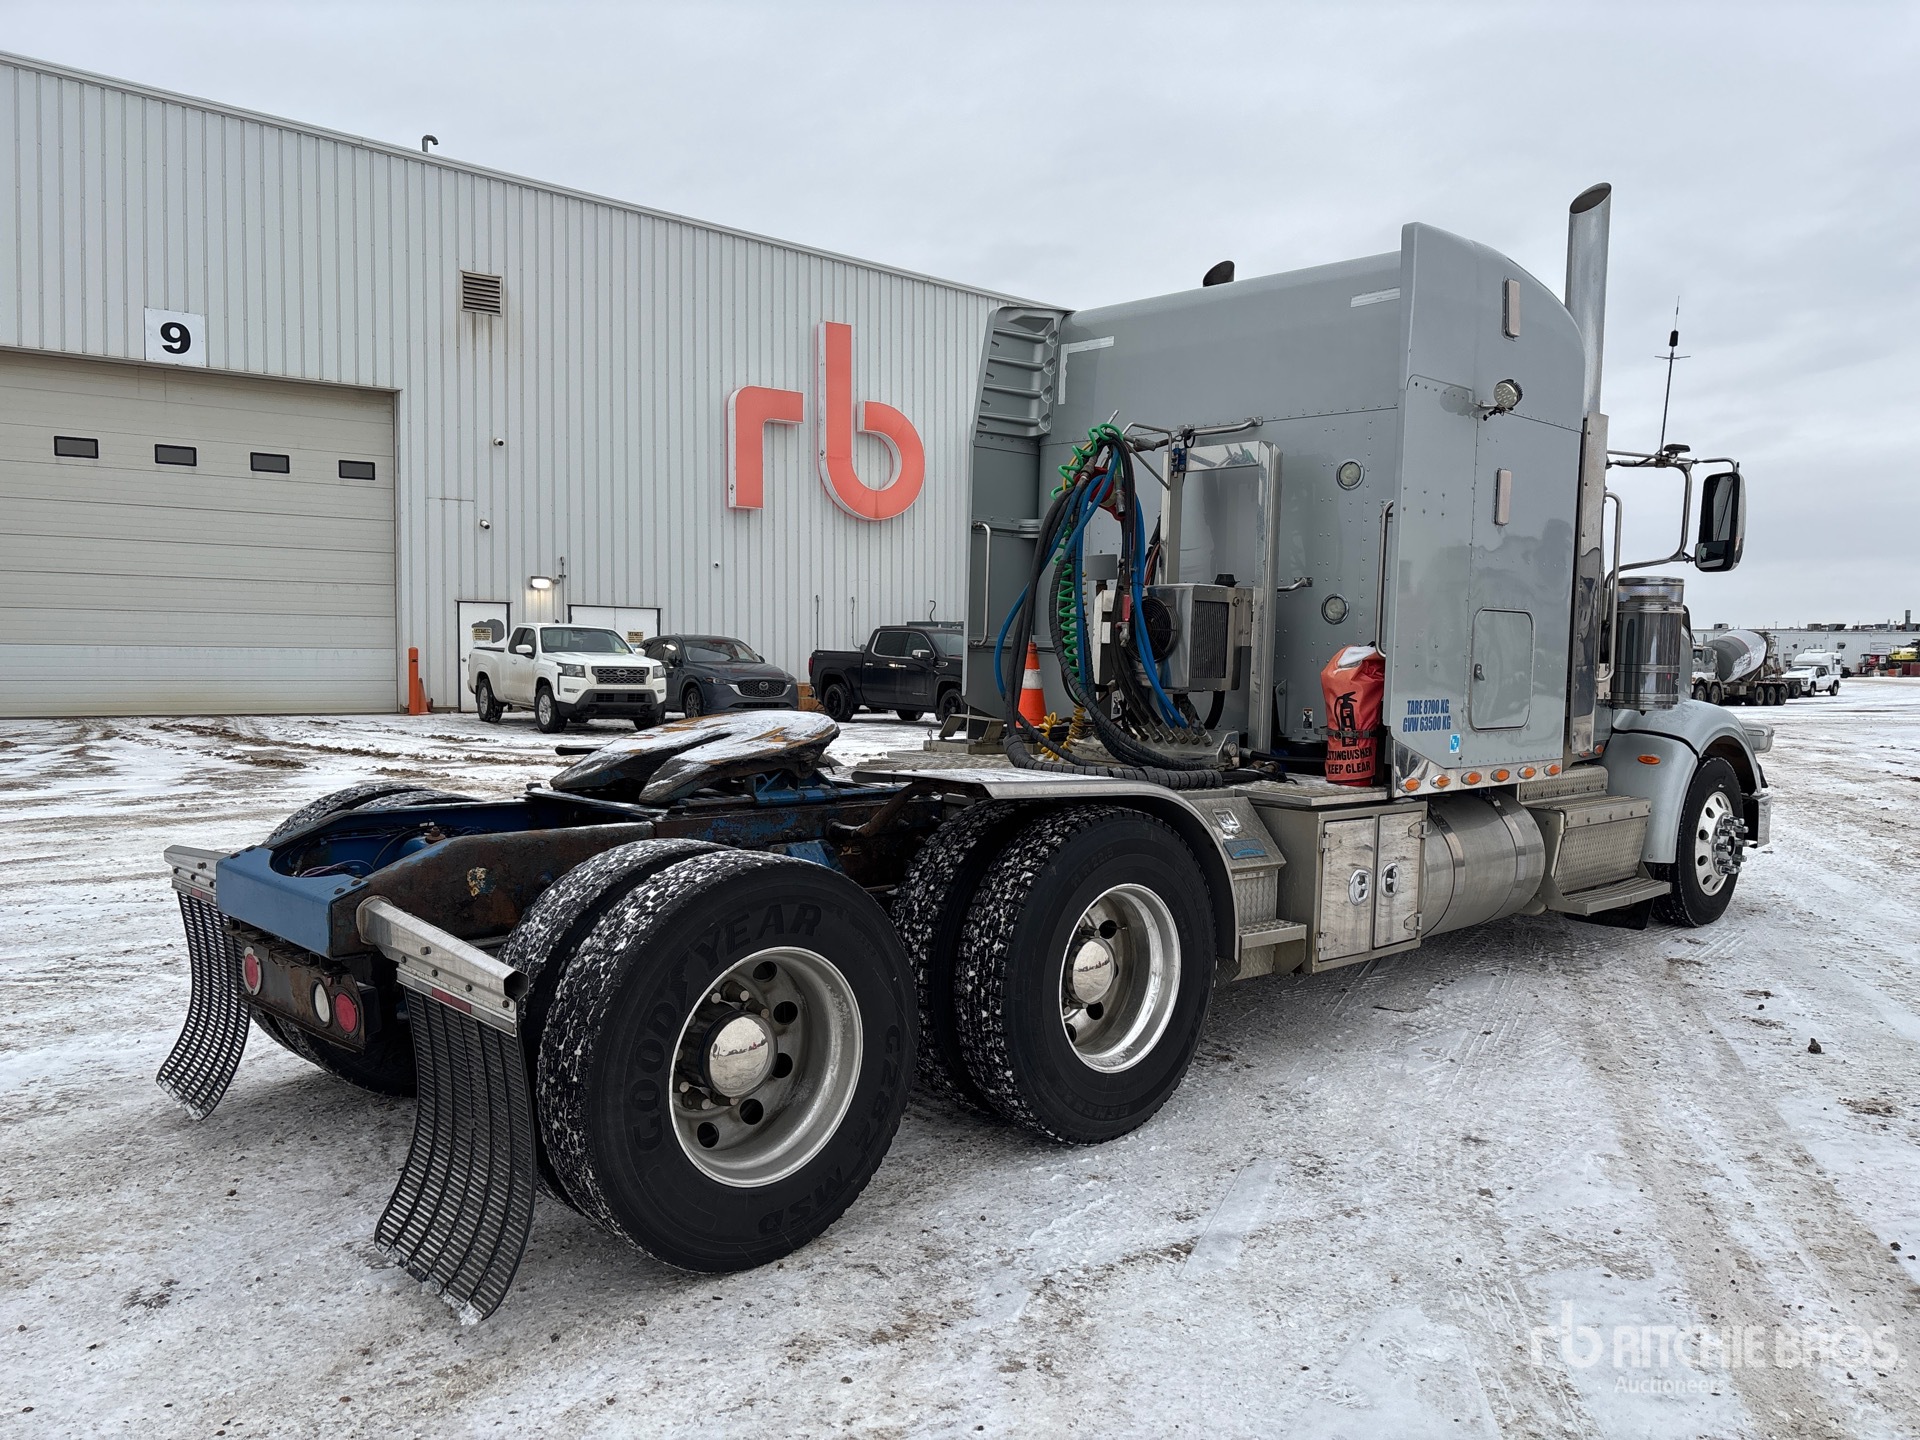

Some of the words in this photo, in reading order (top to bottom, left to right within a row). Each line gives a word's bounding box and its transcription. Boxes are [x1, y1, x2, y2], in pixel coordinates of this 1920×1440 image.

[160, 321, 191, 354] 9
[727, 320, 926, 521] rb
[1407, 700, 1423, 715] TARE
[1424, 699, 1439, 715] 8700
[1441, 699, 1450, 714] KG
[1403, 717, 1419, 732] GVW
[1420, 716, 1441, 731] 63500
[1442, 715, 1451, 730] KG
[1346, 761, 1371, 774] CLEAR
